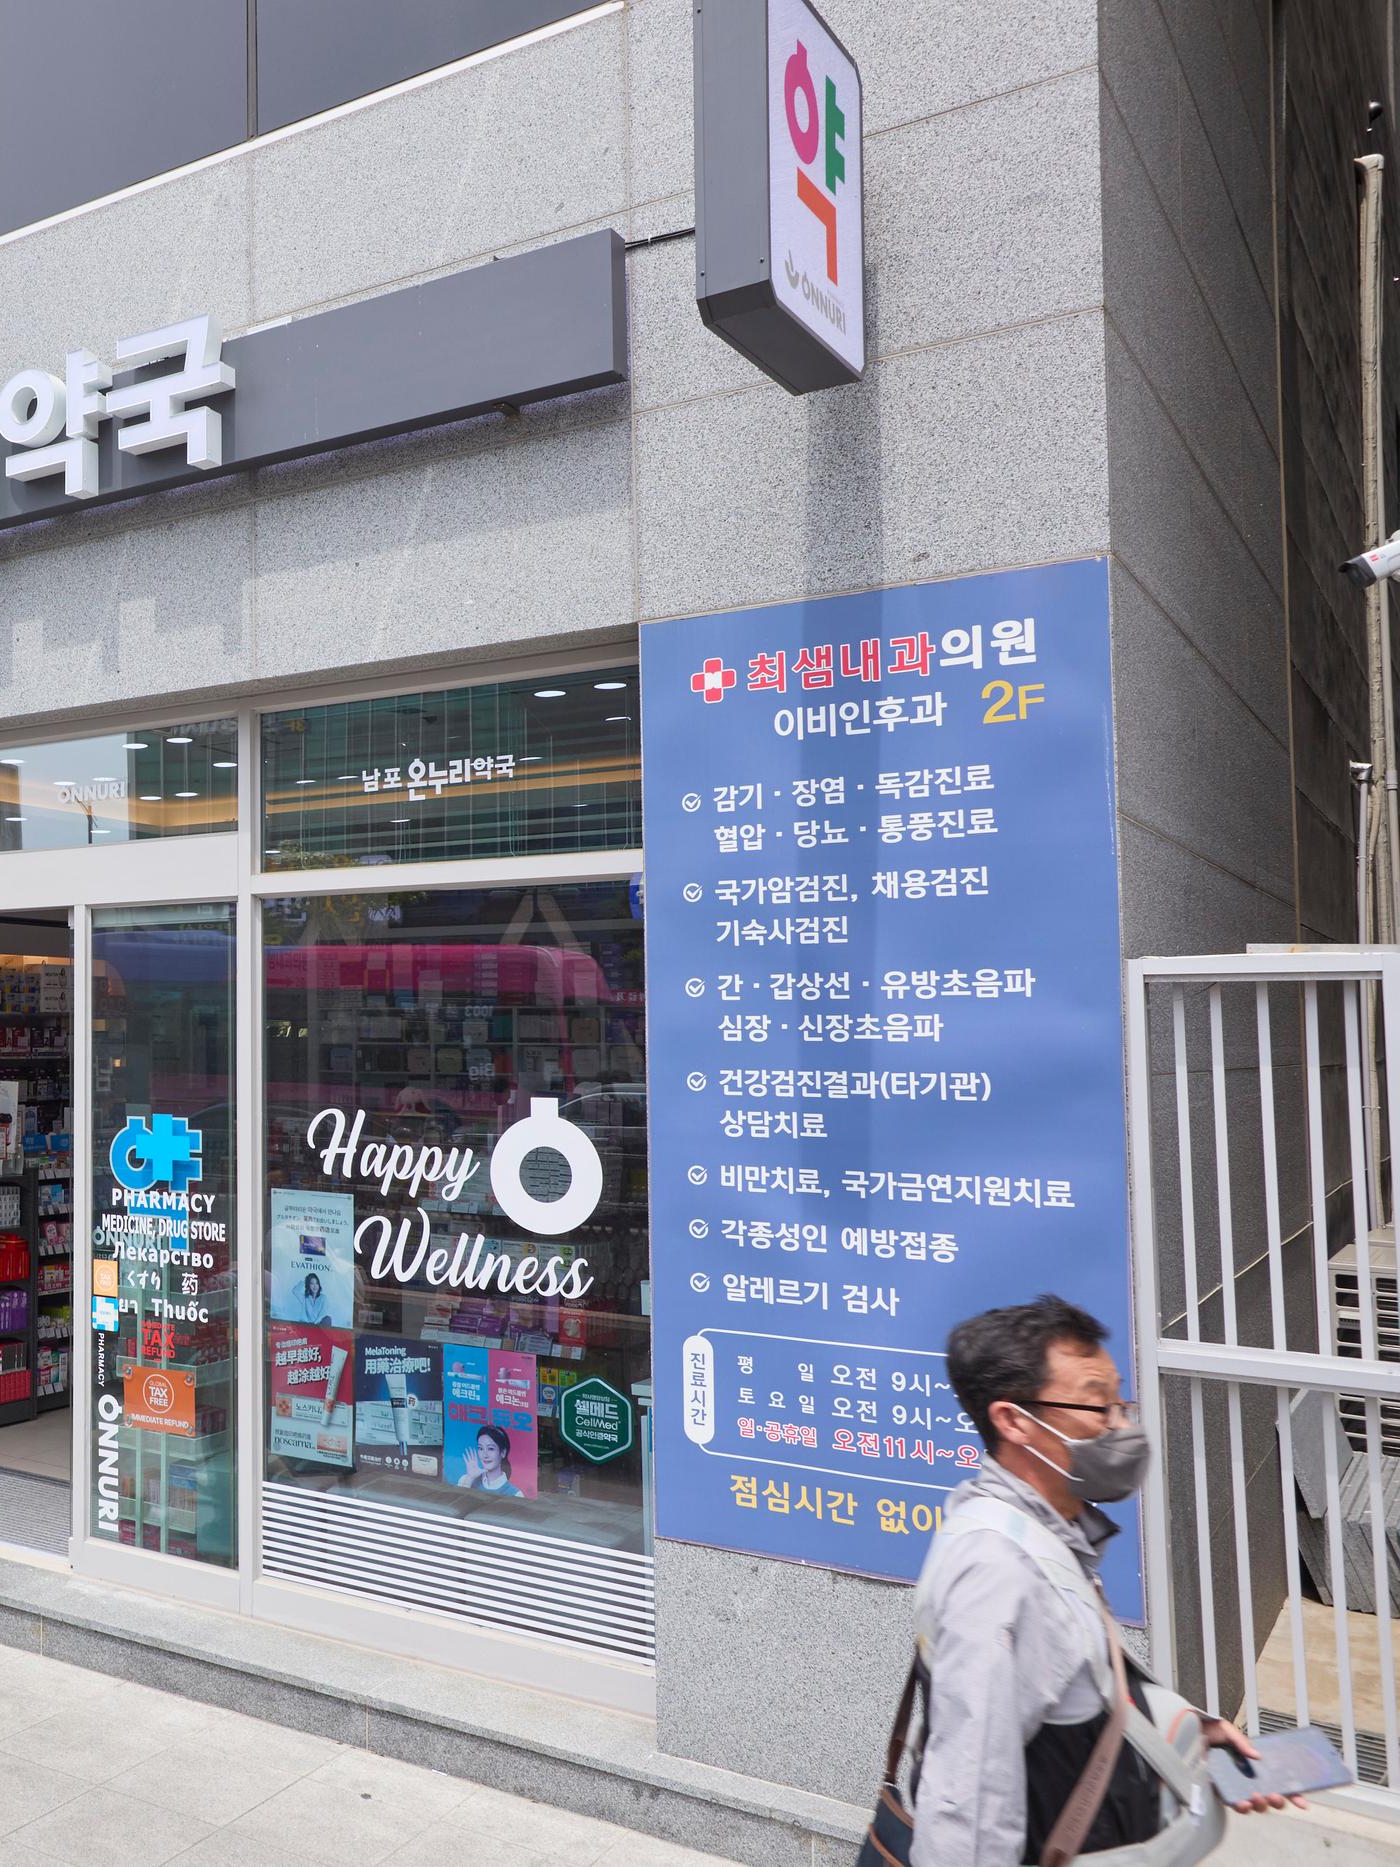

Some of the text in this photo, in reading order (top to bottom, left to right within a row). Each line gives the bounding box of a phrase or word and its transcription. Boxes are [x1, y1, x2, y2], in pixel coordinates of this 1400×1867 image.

[784, 38, 845, 287] 약
[801, 271, 846, 336] ONNURI
[746, 617, 1037, 694] 최샘내과의원
[774, 680, 1046, 741] 이비인후과 2F
[363, 768, 400, 792] 남포
[712, 764, 995, 813] 감기 장염 독감진료
[713, 807, 998, 853] 혈압 당뇨 통풍진료
[714, 866, 990, 906] 국가암검진, 채용검진
[716, 916, 849, 947] 기숙사검진
[717, 968, 1036, 1001] 간 갑상선 유방초음파
[718, 1013, 944, 1042] 심장 신장초음파
[719, 1069, 992, 1102] 건강검진결과(타기관)
[719, 1109, 828, 1139] 상담치료
[307, 1108, 480, 1201] Happy
[111, 1187, 216, 1213] PHARMACY
[720, 1165, 1076, 1208] 비만치료, 국가금연지원치료
[102, 1213, 226, 1242] MEDICINE, DRUG STORE
[720, 1219, 960, 1264] 각종성인 예방접종
[112, 1241, 214, 1269] Лекарство
[291, 1261, 330, 1271] EVATHION
[353, 1206, 595, 1300] Wellness
[126, 1269, 198, 1296] くすり 药
[723, 1272, 900, 1317] 알레르기 검사
[118, 1297, 209, 1323] ยา Thuốc
[141, 1328, 175, 1349] TAX
[141, 1346, 176, 1359] REFUND
[365, 1346, 406, 1356] MelaToning
[148, 1386, 168, 1399] TAX
[690, 1352, 707, 1426] 진료시간
[831, 1364, 877, 1391] 오전
[891, 1372, 958, 1398] 9시~
[149, 1396, 168, 1407] FREE
[831, 1397, 878, 1424] 오전
[575, 1416, 618, 1430] CellMed
[98, 1394, 122, 1532] ONNURI
[729, 1474, 858, 1526] 점심시간
